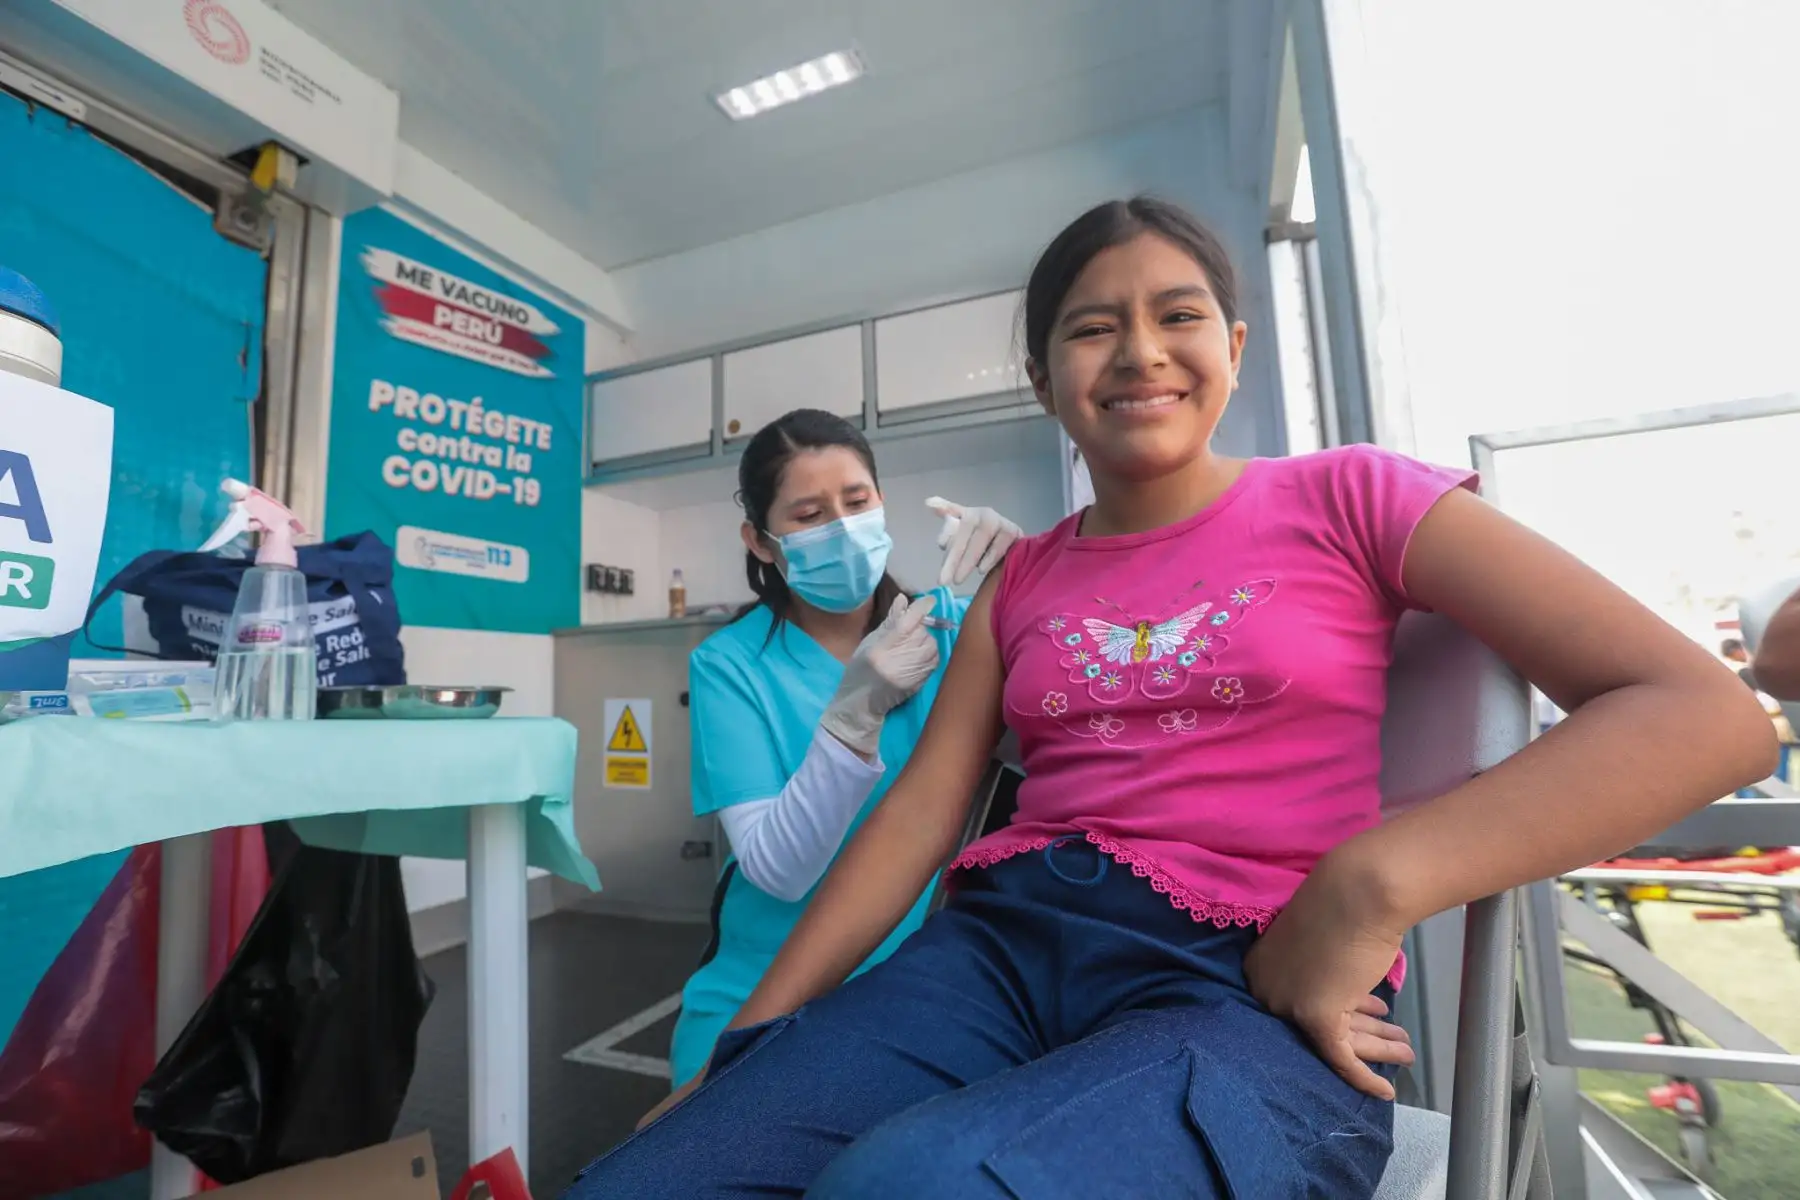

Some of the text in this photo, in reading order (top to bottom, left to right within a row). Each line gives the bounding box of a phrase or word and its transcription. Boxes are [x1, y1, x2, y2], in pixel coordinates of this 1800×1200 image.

[396, 260, 529, 325] ME VACUNO
[433, 303, 503, 345] PERÚ
[368, 378, 553, 450] PROTÉGETE
[397, 428, 532, 473] contra la
[382, 455, 541, 506] COVID-19
[188, 613, 225, 637] Mini
[326, 626, 364, 653] Red
